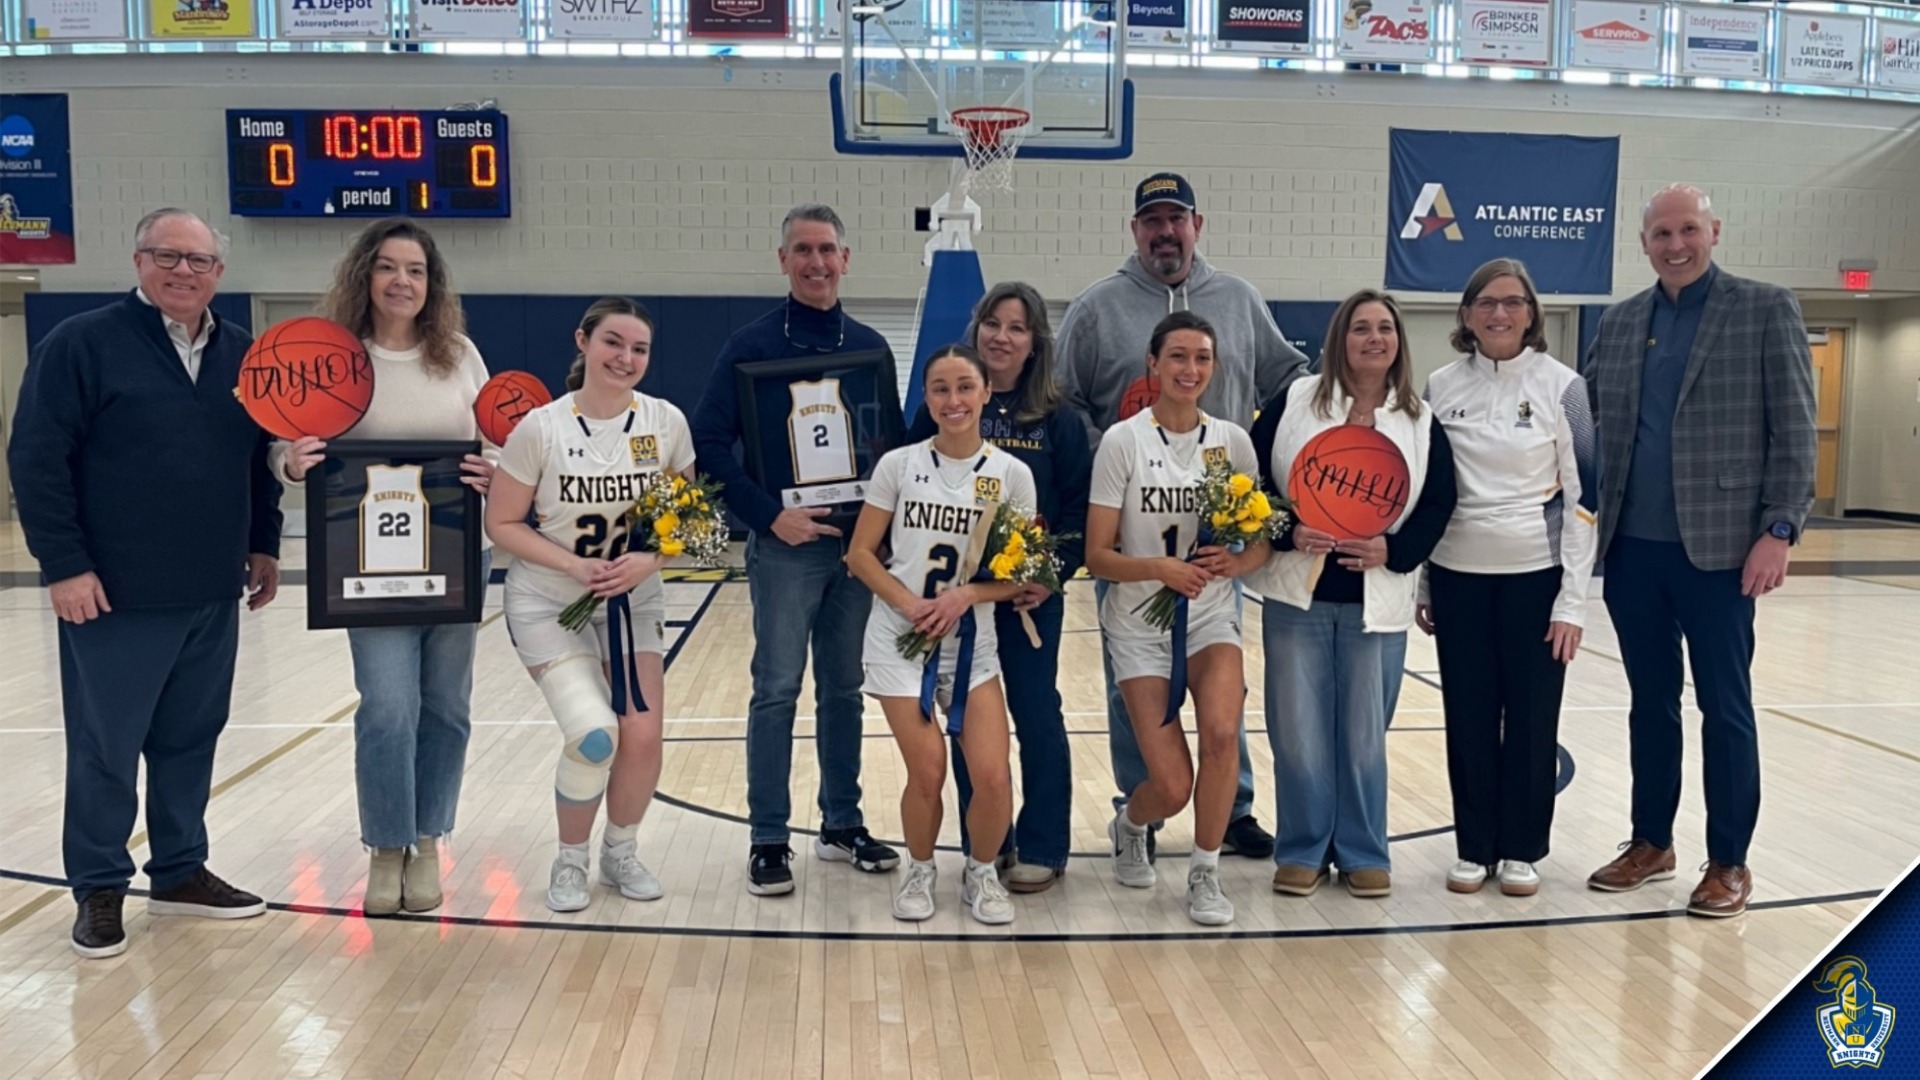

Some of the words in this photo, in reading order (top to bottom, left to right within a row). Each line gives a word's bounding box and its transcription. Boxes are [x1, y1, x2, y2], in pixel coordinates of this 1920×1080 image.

[320, 0, 372, 13] Depot
[1132, 4, 1175, 16] Beyond.
[1229, 7, 1304, 22] SHOWORKS
[1489, 10, 1539, 22] BRINKER
[1690, 16, 1758, 30] Independence
[1367, 15, 1428, 41] ZAC'S
[1481, 20, 1539, 34] SIMPSON
[1592, 28, 1640, 40] SERVPRO
[1800, 46, 1819, 57] LATE
[1821, 47, 1845, 58] NIGHT
[1898, 38, 1920, 57] Hil
[1790, 57, 1803, 66] 1/2
[1803, 57, 1832, 69] PRICED
[1833, 60, 1854, 71] APPS
[1, 135, 35, 147] NCAA
[240, 118, 285, 137] Home
[323, 114, 422, 159] 10:00
[437, 118, 493, 138] Guests
[268, 143, 296, 187] 0
[470, 144, 497, 188] 0
[342, 187, 392, 209] period
[420, 182, 429, 210] 1
[1475, 205, 1558, 222] ATLANTIC
[1563, 207, 1606, 223] EAST
[1493, 224, 1586, 240] CONFERENCE
[1849, 271, 1870, 289] EXIT
[241, 351, 371, 407] TAYLOR
[632, 436, 656, 451] 60
[813, 424, 829, 448] 2
[1206, 449, 1226, 463] 60
[976, 477, 999, 492] 60
[1303, 456, 1406, 518] EMILY
[1141, 487, 1200, 513] KNIG
[378, 512, 411, 537] 22
[903, 500, 984, 535] KNIGHT
[923, 543, 959, 599] 2
